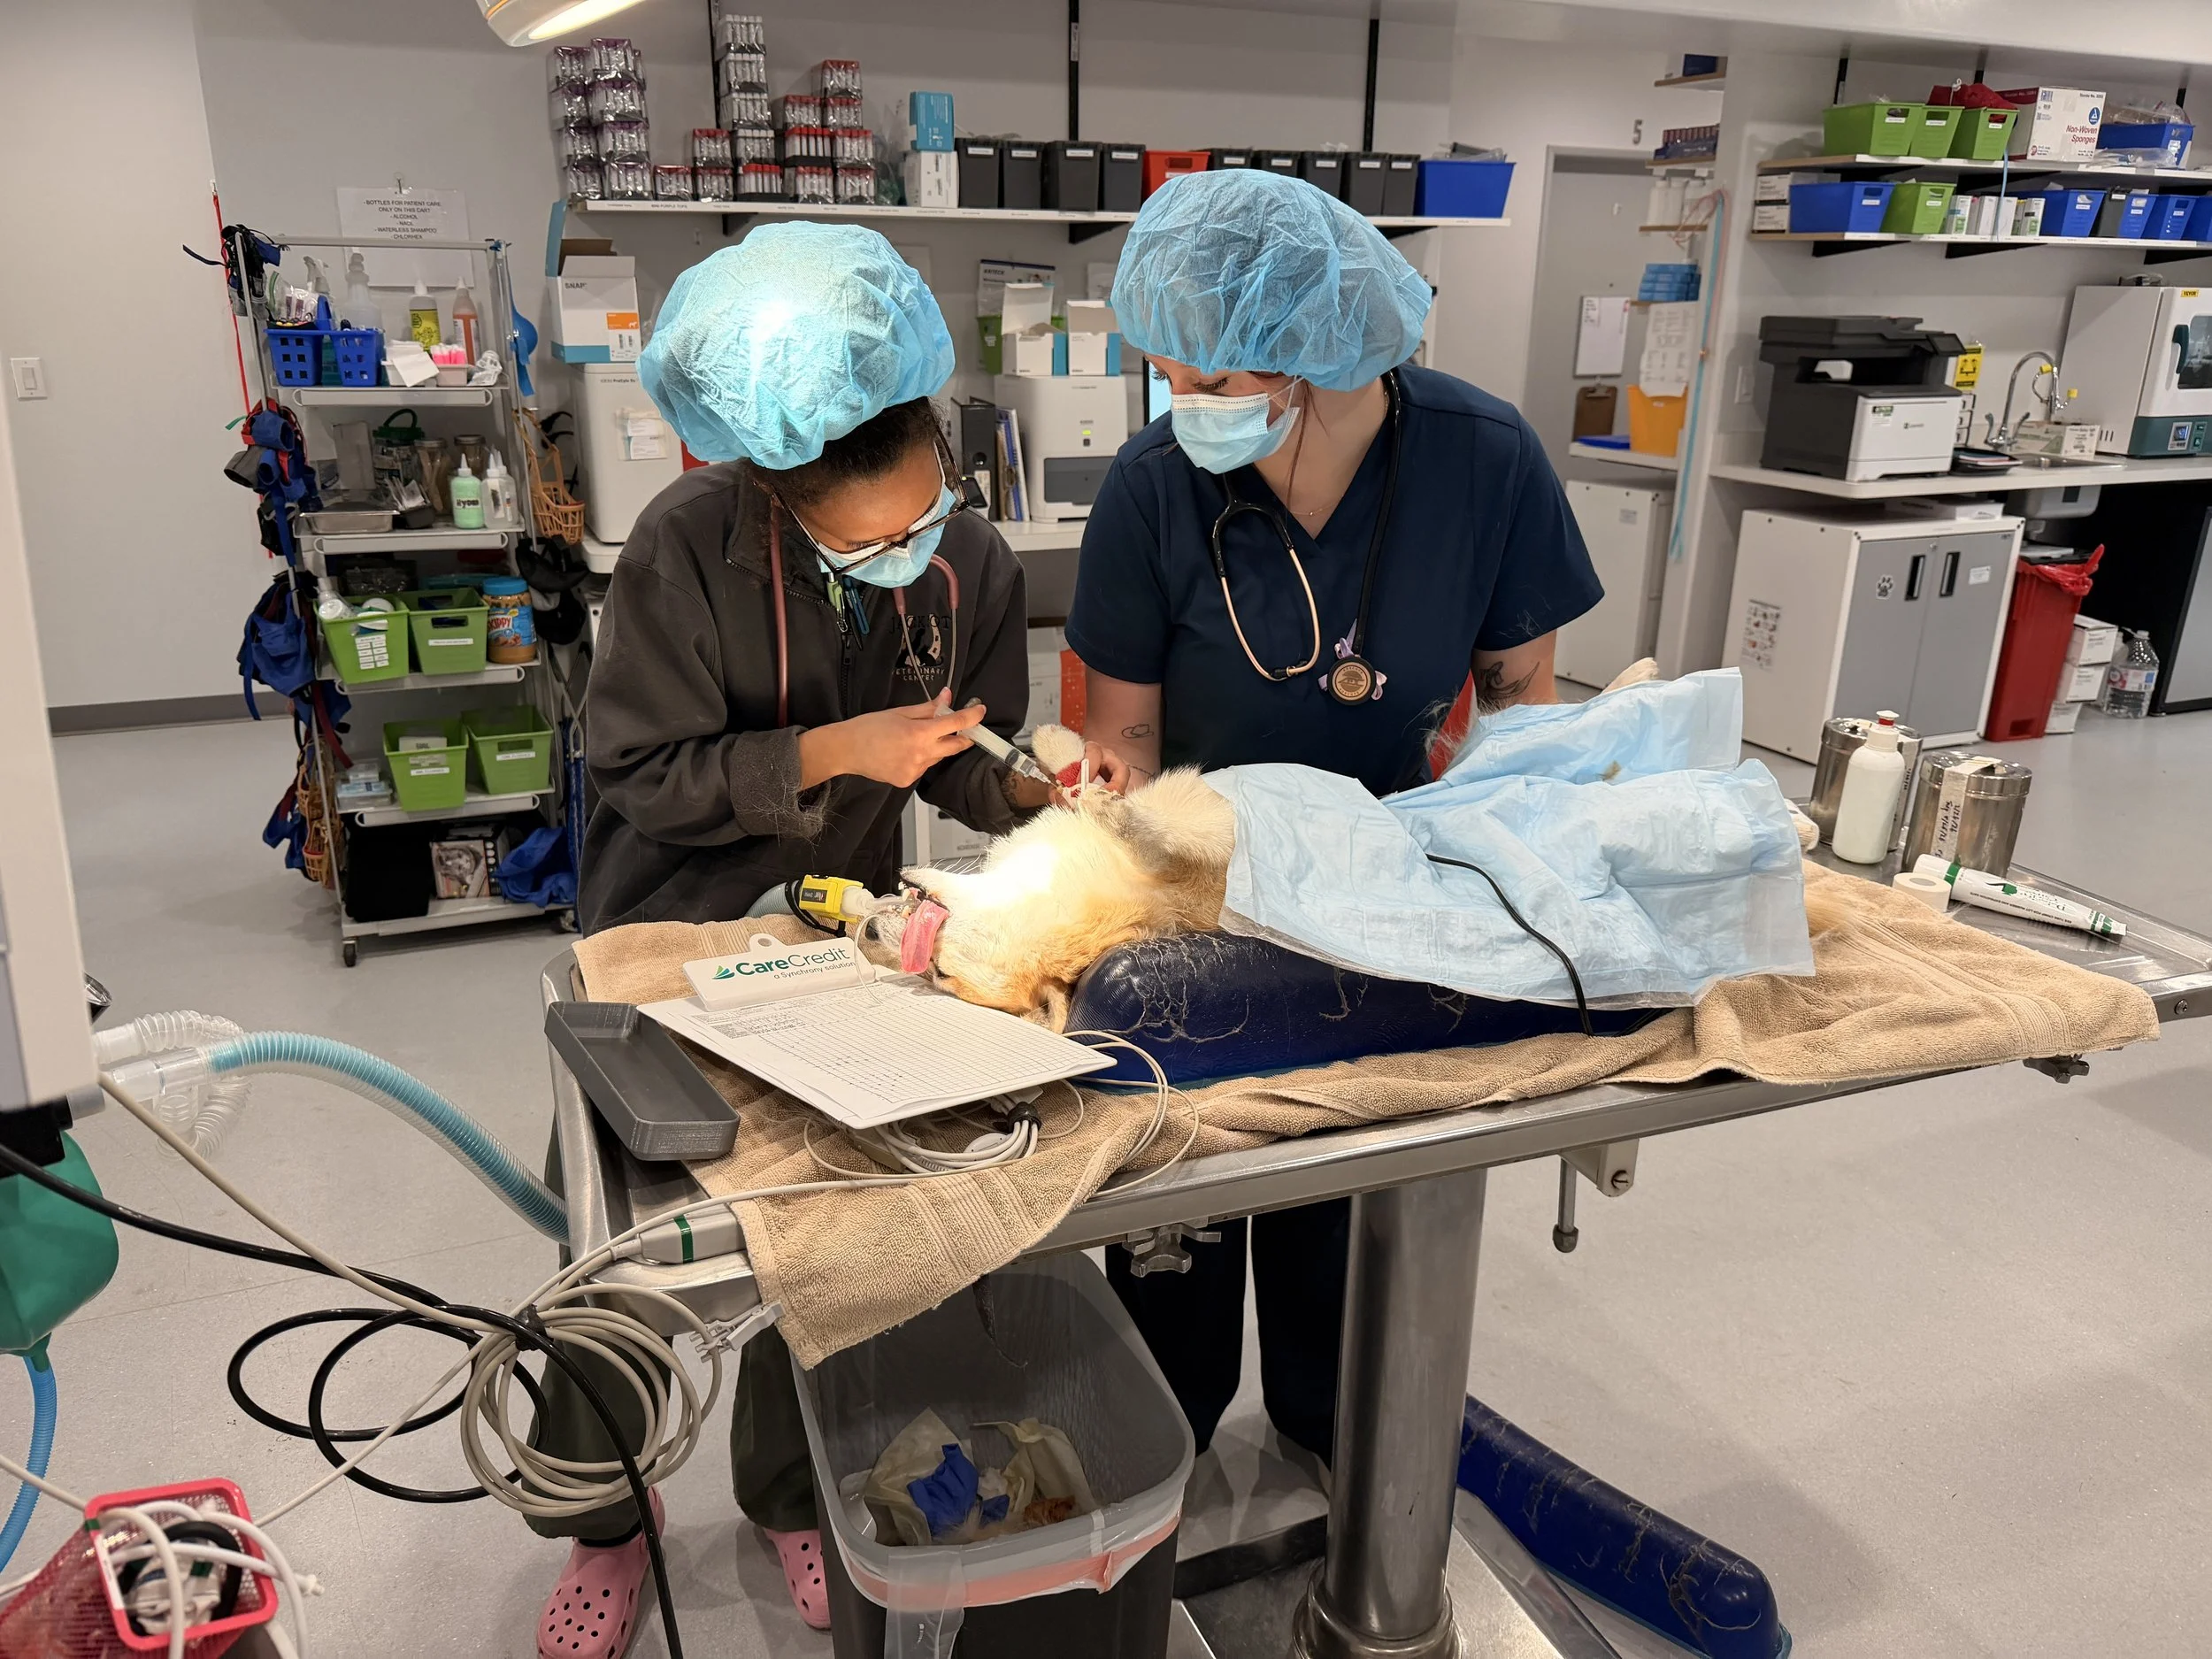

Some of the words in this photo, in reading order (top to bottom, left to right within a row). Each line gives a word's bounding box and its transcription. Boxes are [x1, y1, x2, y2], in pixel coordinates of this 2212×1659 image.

[1632, 119, 1643, 145] 5
[2066, 125, 2098, 134] Non-Woven
[2071, 134, 2096, 144] Sponges
[891, 667, 945, 676] ETEINARY
[735, 948, 850, 975] CareCredit
[780, 965, 824, 979] Synchrony
